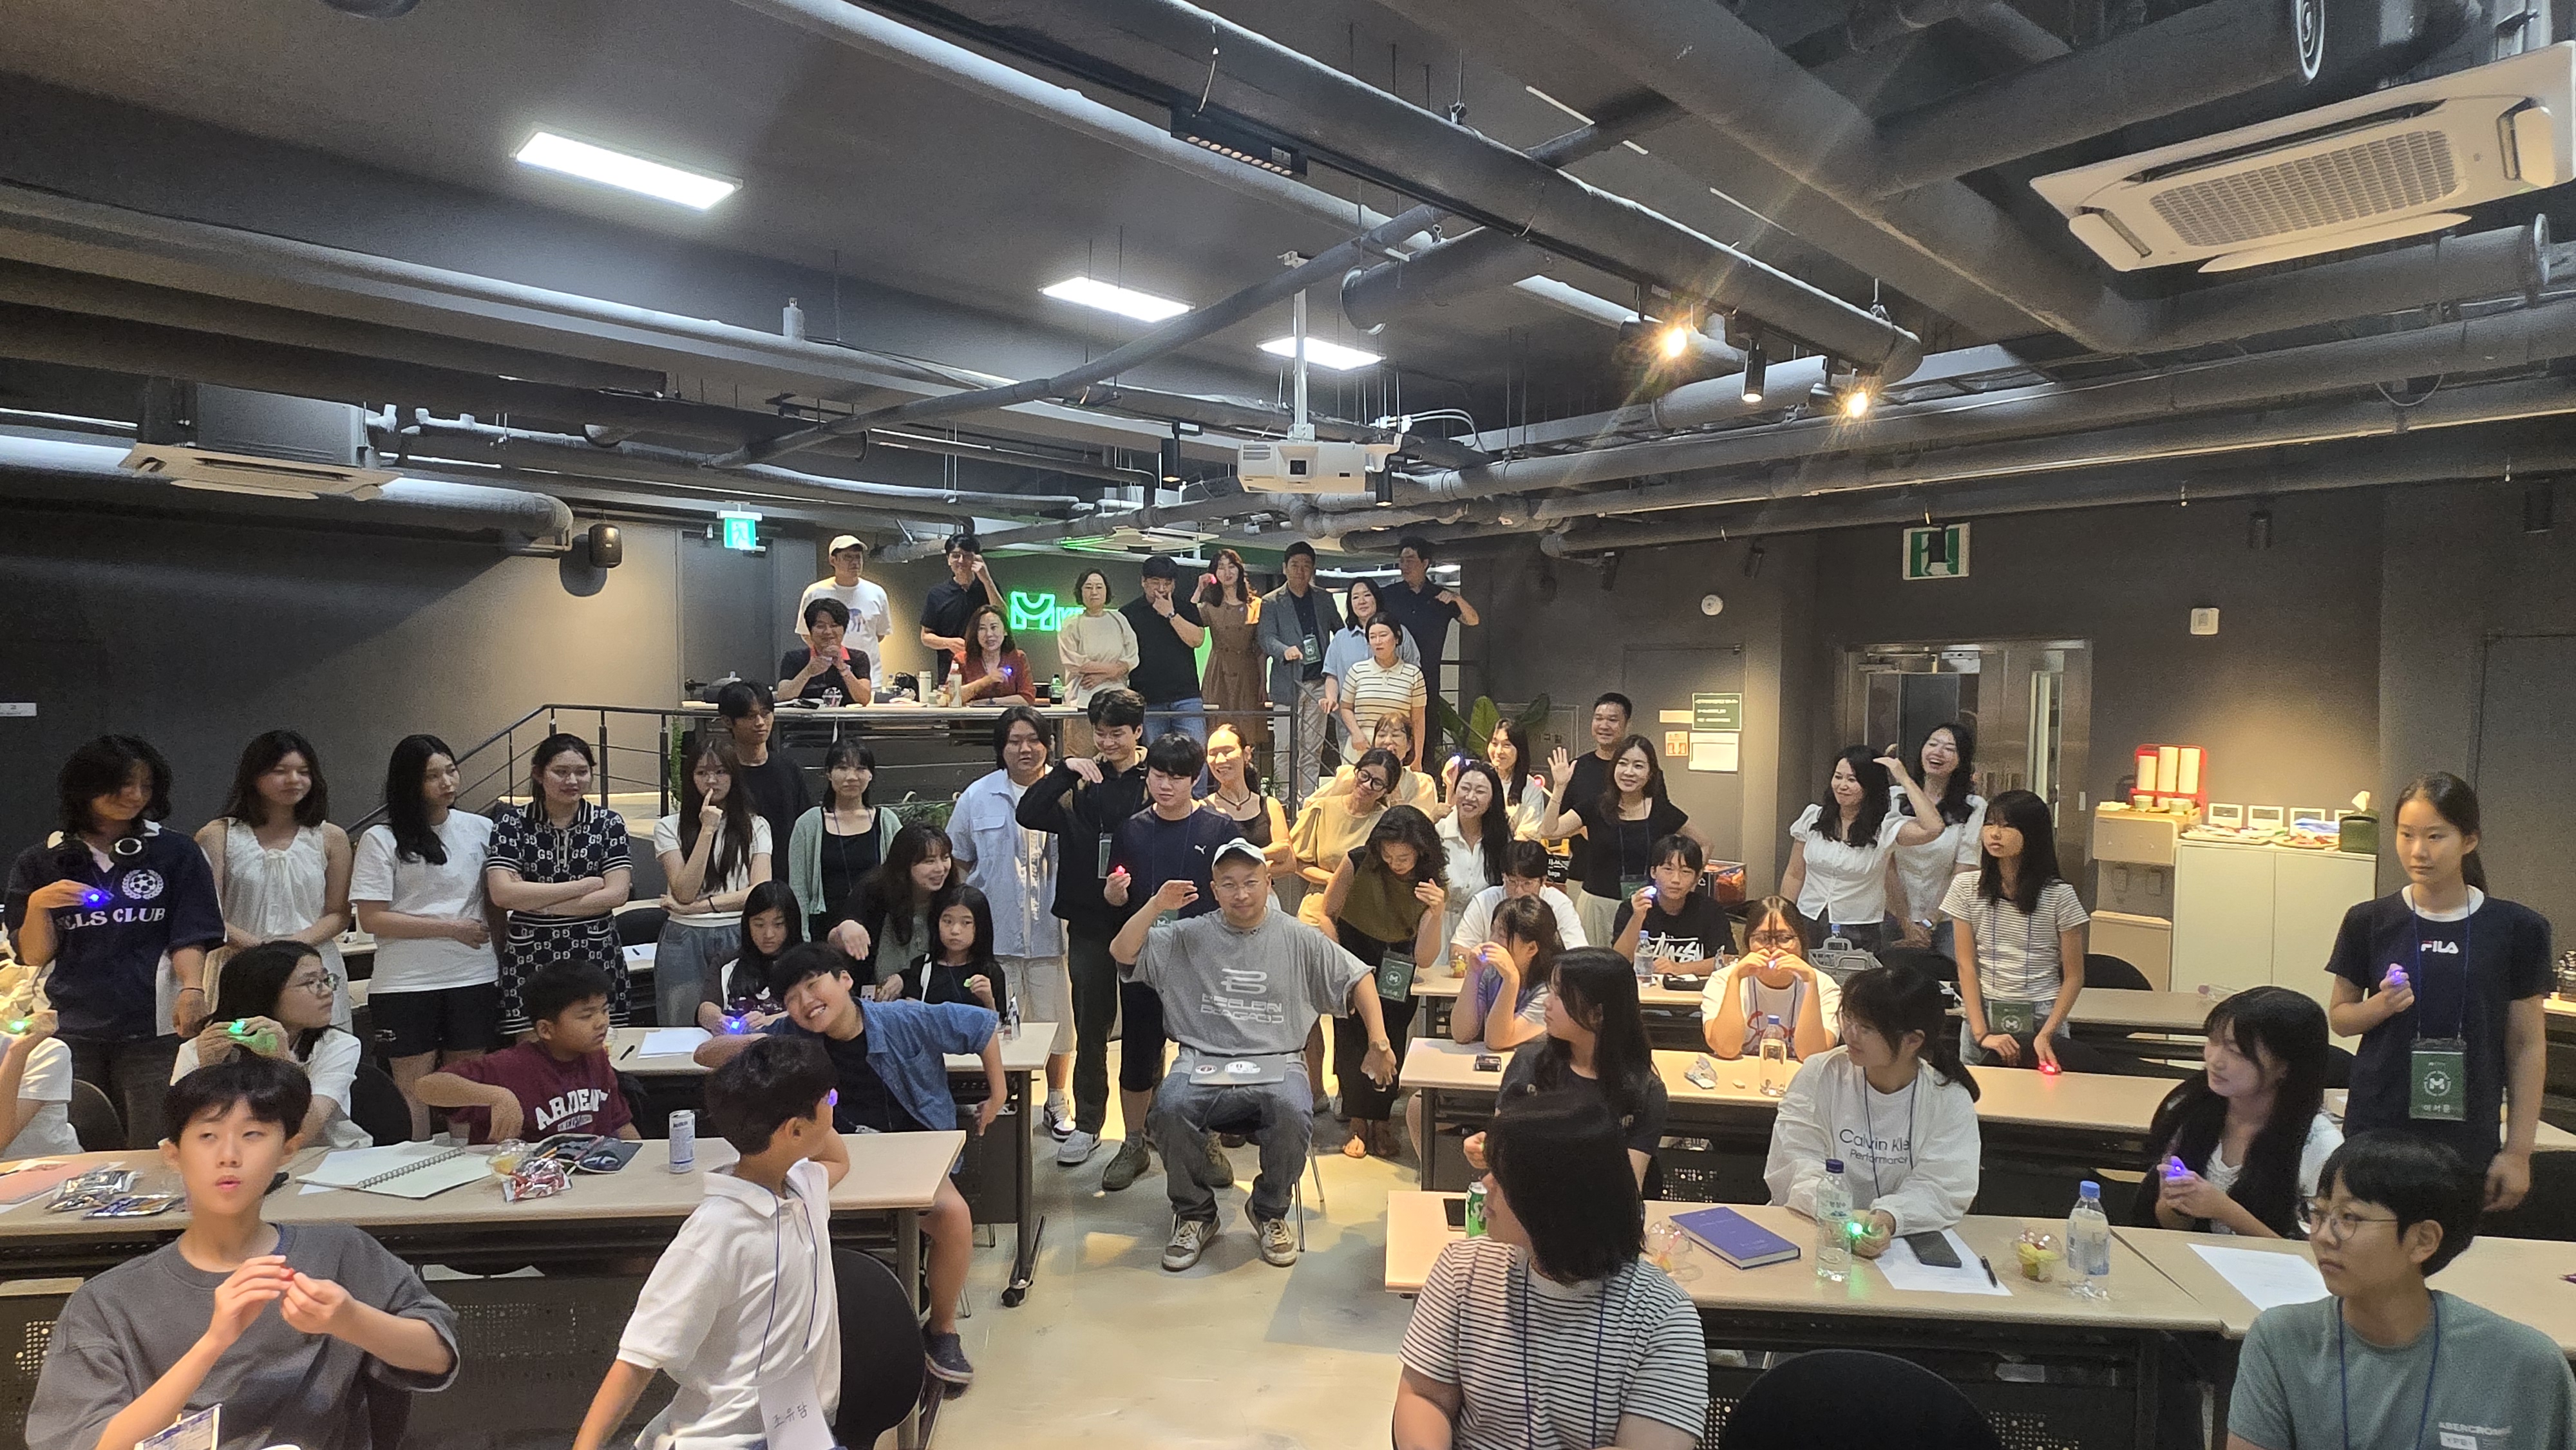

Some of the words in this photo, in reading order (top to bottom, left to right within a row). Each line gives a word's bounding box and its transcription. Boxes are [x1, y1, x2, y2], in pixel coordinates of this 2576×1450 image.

[112, 908, 166, 923] CLUB
[2420, 940, 2459, 954] FILA
[1839, 1129, 1888, 1151] Calvin
[1891, 1136, 1910, 1152] Kle
